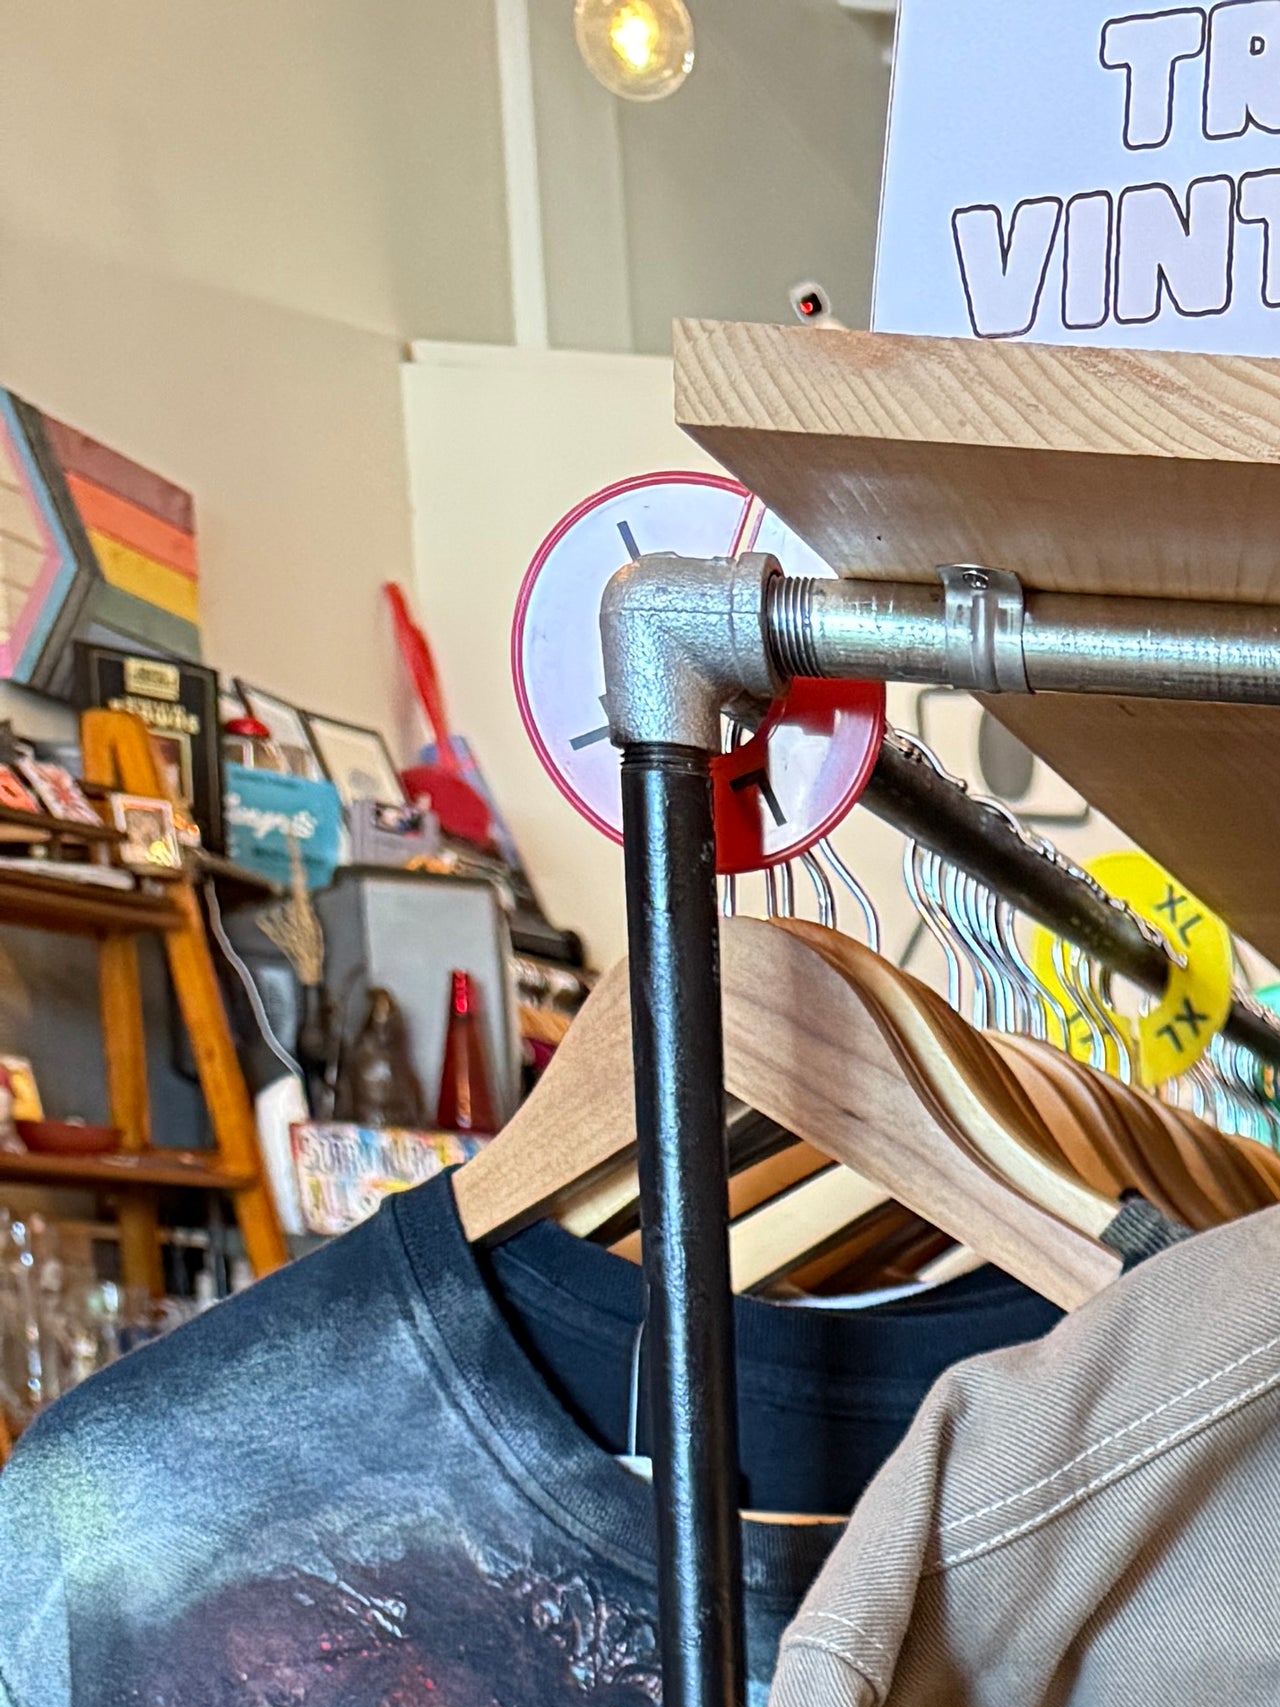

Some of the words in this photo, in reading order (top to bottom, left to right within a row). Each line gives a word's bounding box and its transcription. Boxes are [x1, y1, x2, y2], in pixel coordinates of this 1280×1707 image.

[729, 767, 787, 827] L
[1155, 883, 1204, 947] XL
[1157, 998, 1208, 1053] XL
